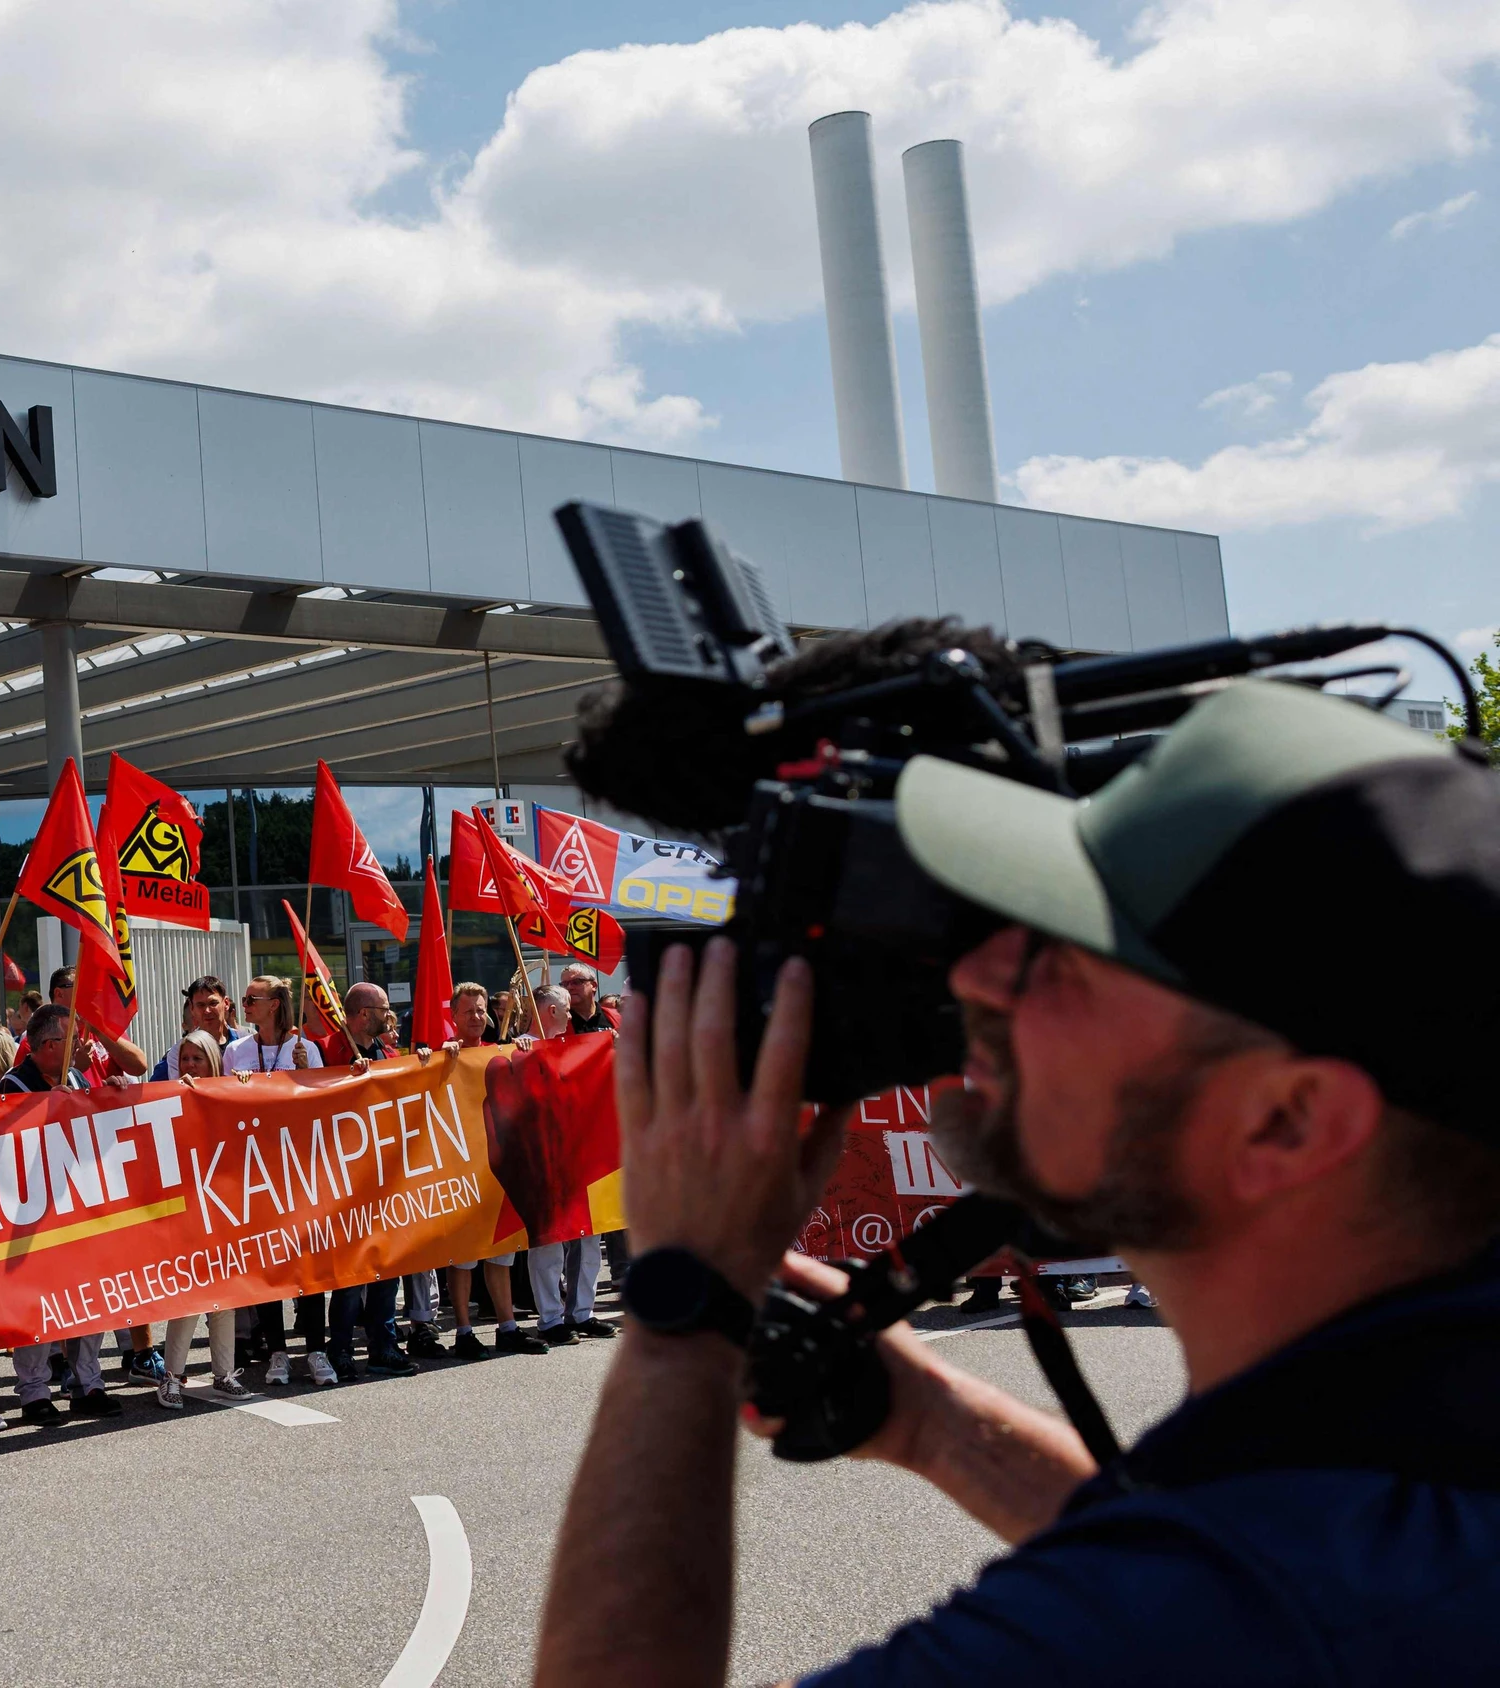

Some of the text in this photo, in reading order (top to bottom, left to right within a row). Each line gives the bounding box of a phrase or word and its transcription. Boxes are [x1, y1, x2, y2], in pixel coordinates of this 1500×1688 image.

[137, 879, 203, 911] Metall
[190, 1083, 471, 1235] KÄMPFEN
[40, 1172, 482, 1334] ALLE BELEGSCHAFTEN IM VW-KONZERN
